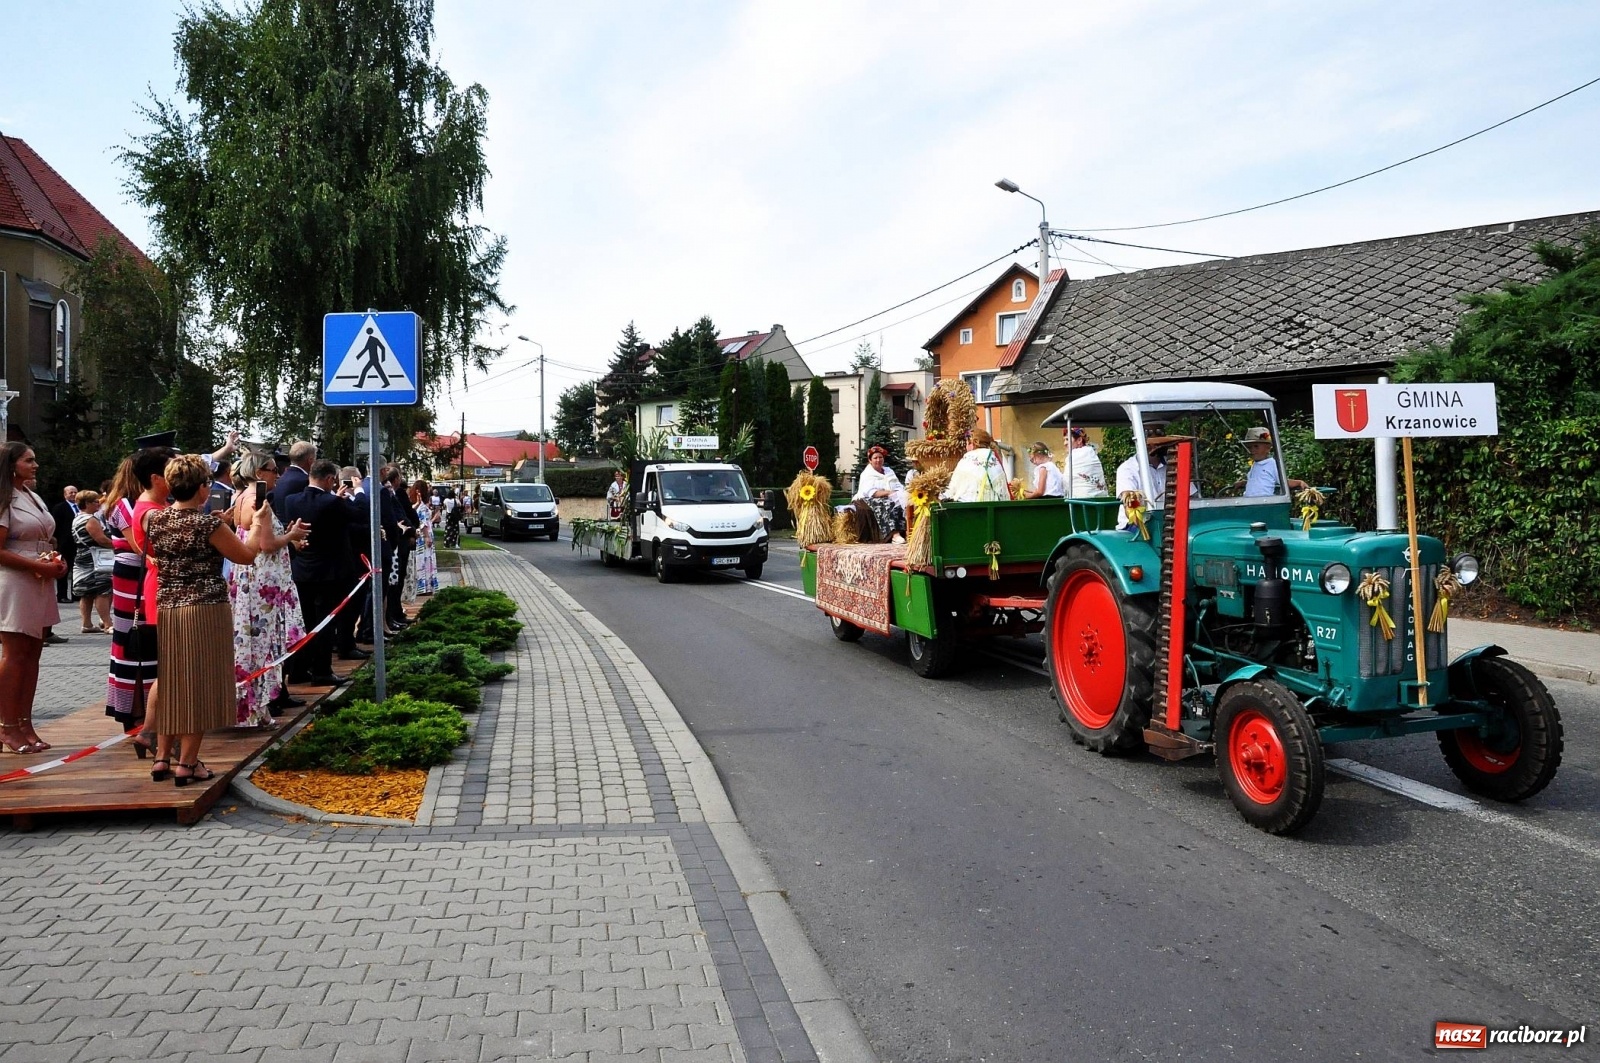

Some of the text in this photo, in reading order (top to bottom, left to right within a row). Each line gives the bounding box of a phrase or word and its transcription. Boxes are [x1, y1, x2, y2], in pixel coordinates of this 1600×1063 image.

[1397, 390, 1464, 409] GMINA
[1385, 414, 1478, 430] Krzanowice
[805, 454, 818, 462] STOP
[1246, 564, 1320, 583] HAOMA
